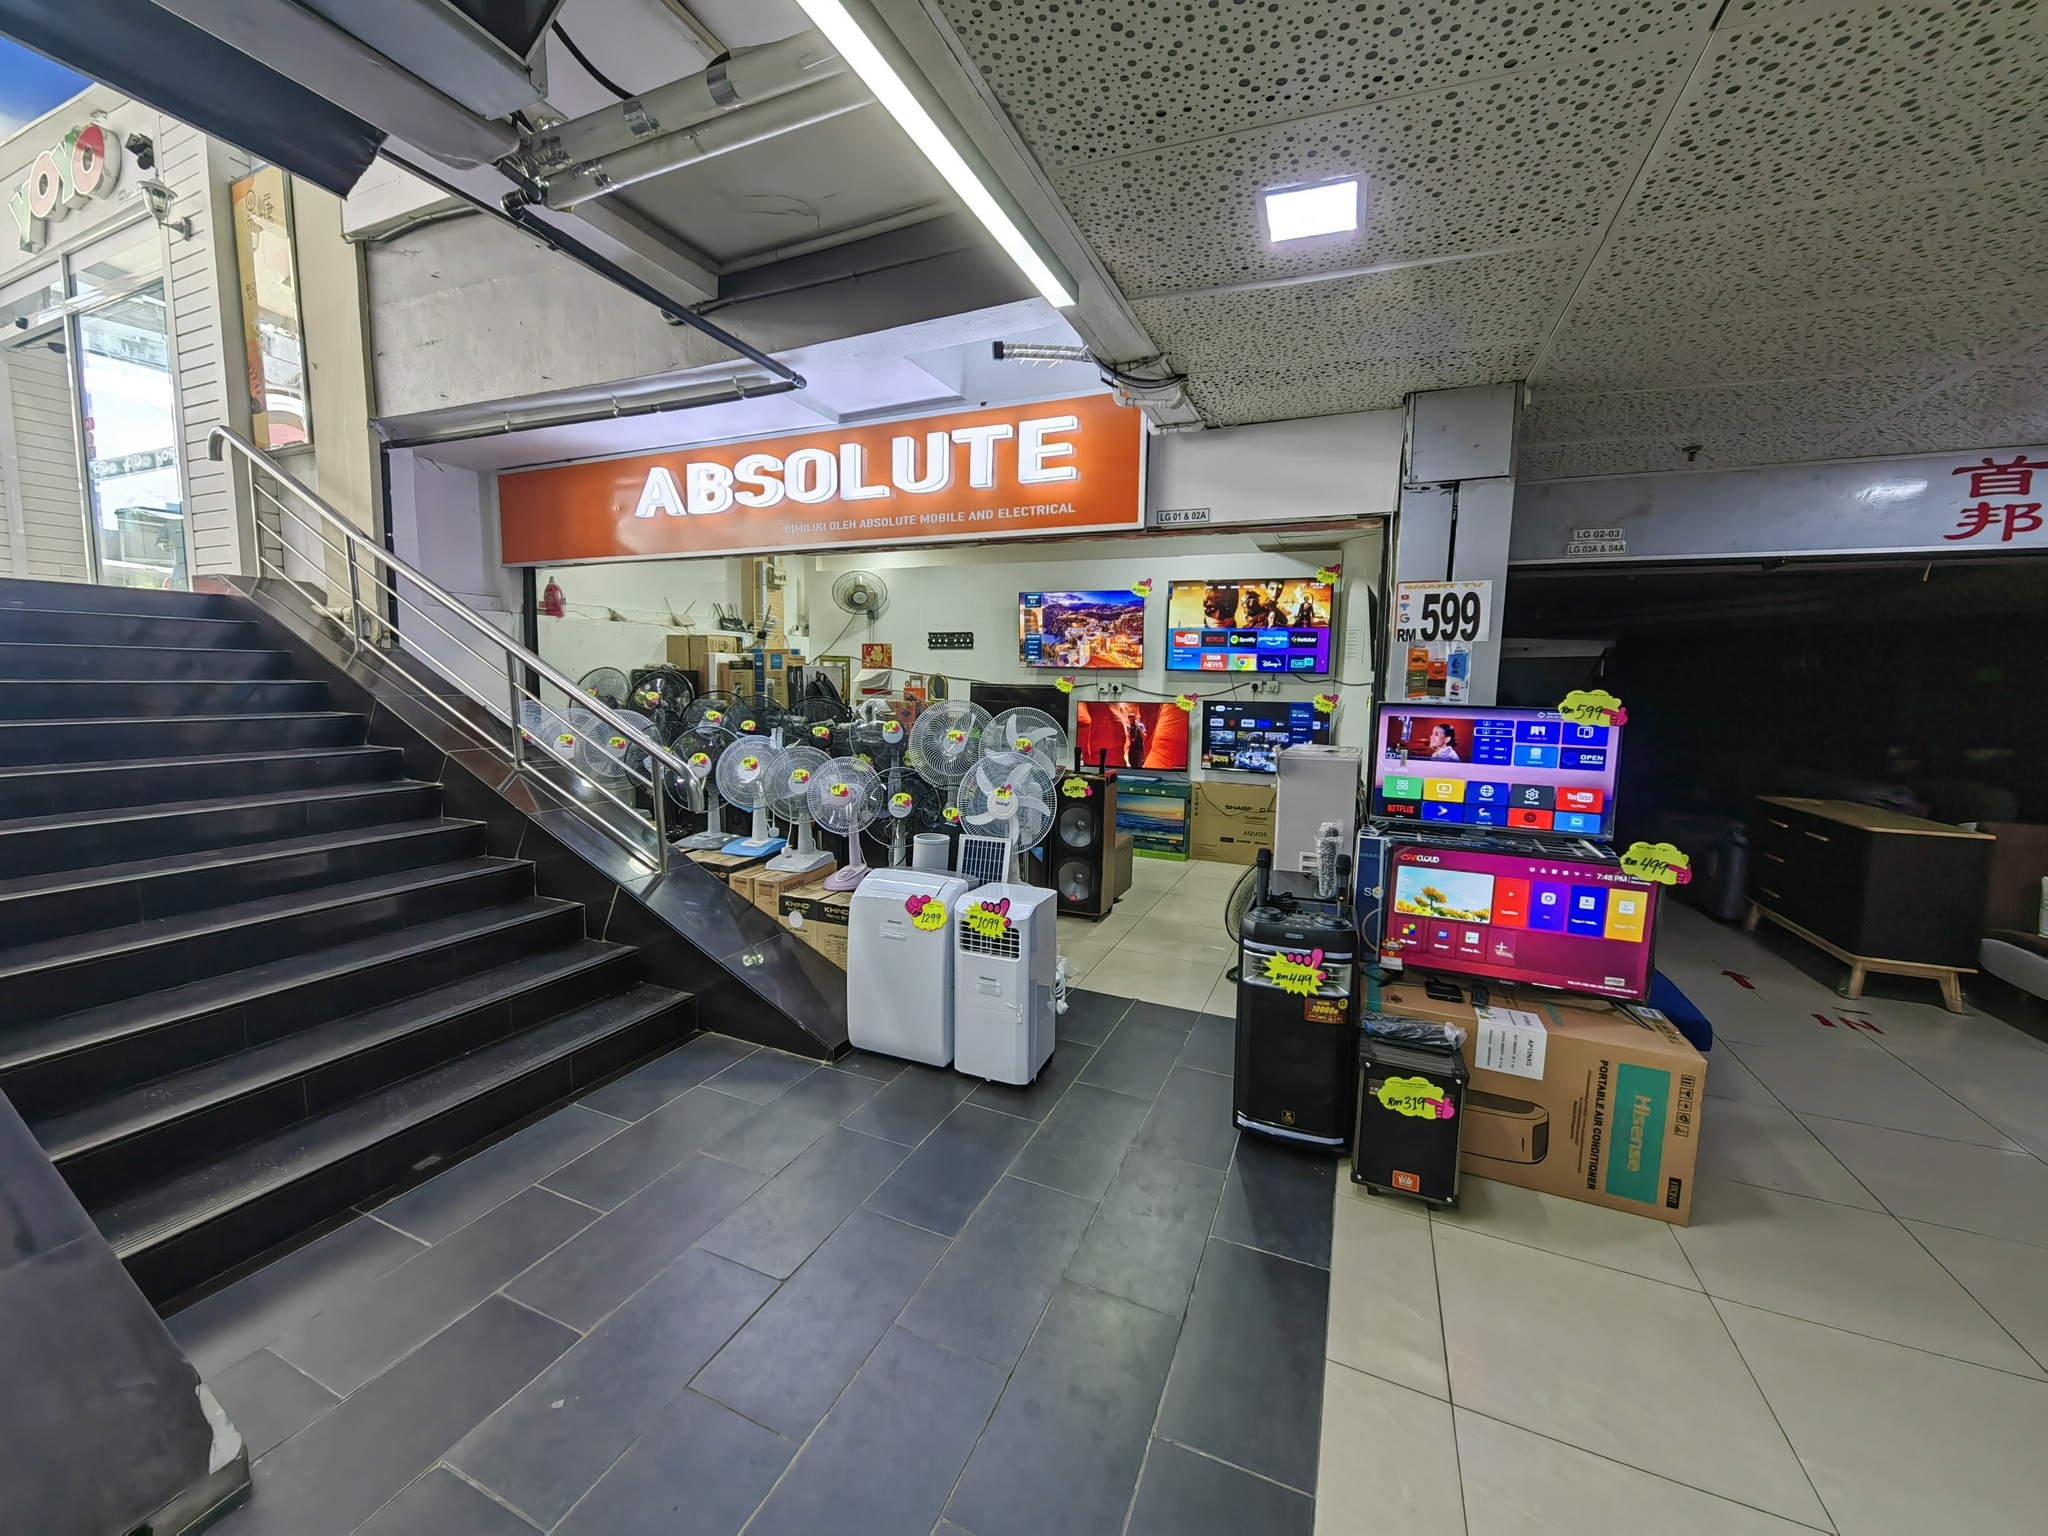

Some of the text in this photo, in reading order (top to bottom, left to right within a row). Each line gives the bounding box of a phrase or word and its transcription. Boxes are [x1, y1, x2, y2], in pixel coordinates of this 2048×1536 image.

[8, 125, 119, 253] YOYO
[635, 415, 1078, 518] ABSOLUTE
[784, 502, 1076, 534] DIMILIKI OLEH ABSOLUTE MOBILE AND ELECTRICAL
[1160, 513, 1171, 521] LG
[1184, 512, 1190, 520] &
[1192, 511, 1206, 519] 02A
[1594, 530, 1620, 538] 02-03
[1582, 545, 1598, 553] 03A
[1608, 544, 1624, 552] 04A
[1397, 591, 1480, 642] RM 599
[1574, 704, 1603, 720] 599
[1566, 792, 1594, 802] YouTube
[1225, 804, 1252, 812] SHARP
[1387, 804, 1414, 814] NETFLIX
[1640, 857, 1668, 875] 499
[1596, 873, 1613, 882] 7:48
[785, 900, 810, 909] KHIND
[824, 906, 849, 916] KHIND
[921, 912, 942, 925] 1299
[977, 916, 1000, 928] 1099
[1288, 972, 1312, 986] 449
[1526, 1038, 1534, 1067] AP12NXG
[1403, 1096, 1426, 1112] 319
[1586, 1059, 1610, 1190] PORTABLE AIR CONDITIONER
[1626, 1094, 1653, 1173] Hisense
[1668, 1180, 1679, 1207] FRONT
